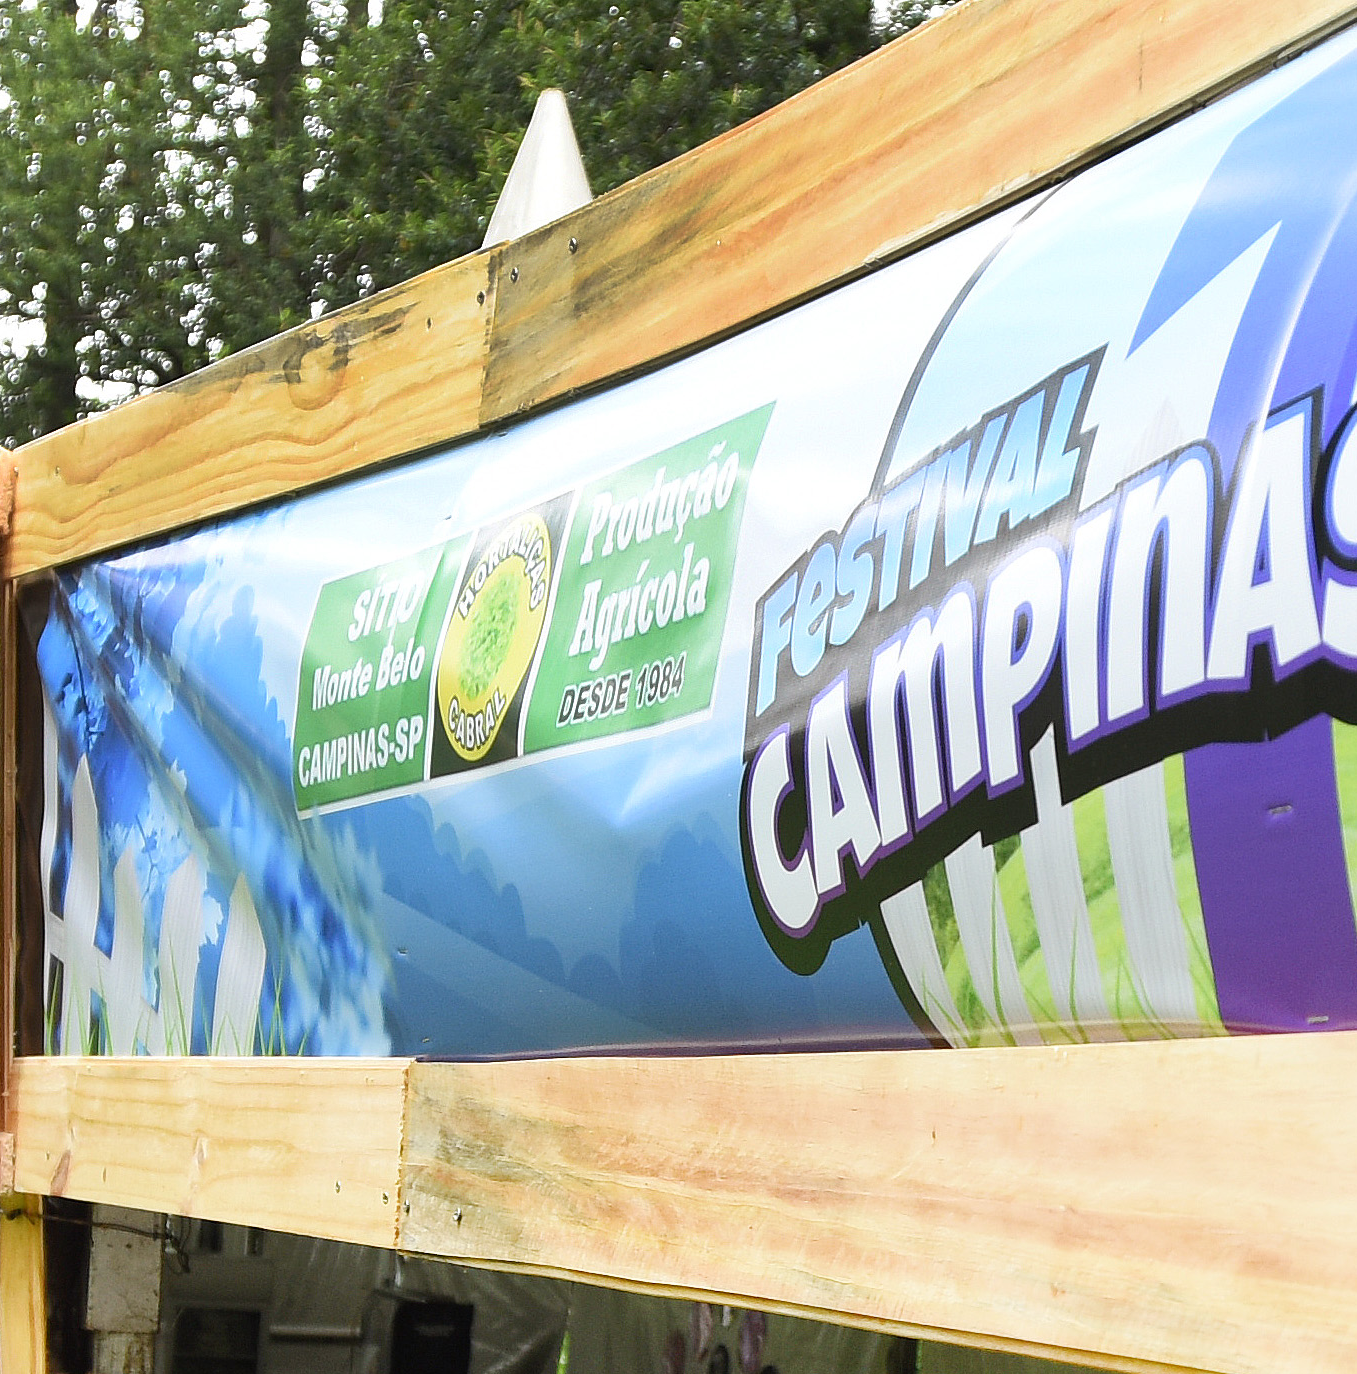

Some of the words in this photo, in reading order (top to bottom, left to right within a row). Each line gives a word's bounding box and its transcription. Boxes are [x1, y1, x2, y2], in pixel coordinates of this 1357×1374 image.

[580, 440, 739, 566] Produção
[458, 516, 547, 621] HORTALIÇAS
[568, 541, 710, 672] Agrícola
[312, 656, 374, 712] Monte
[375, 637, 426, 692] Belo
[556, 669, 632, 728] DESDE
[636, 651, 687, 707] 1984
[298, 714, 424, 789] CAMPINAS-SP
[448, 687, 507, 752] CABRAL
